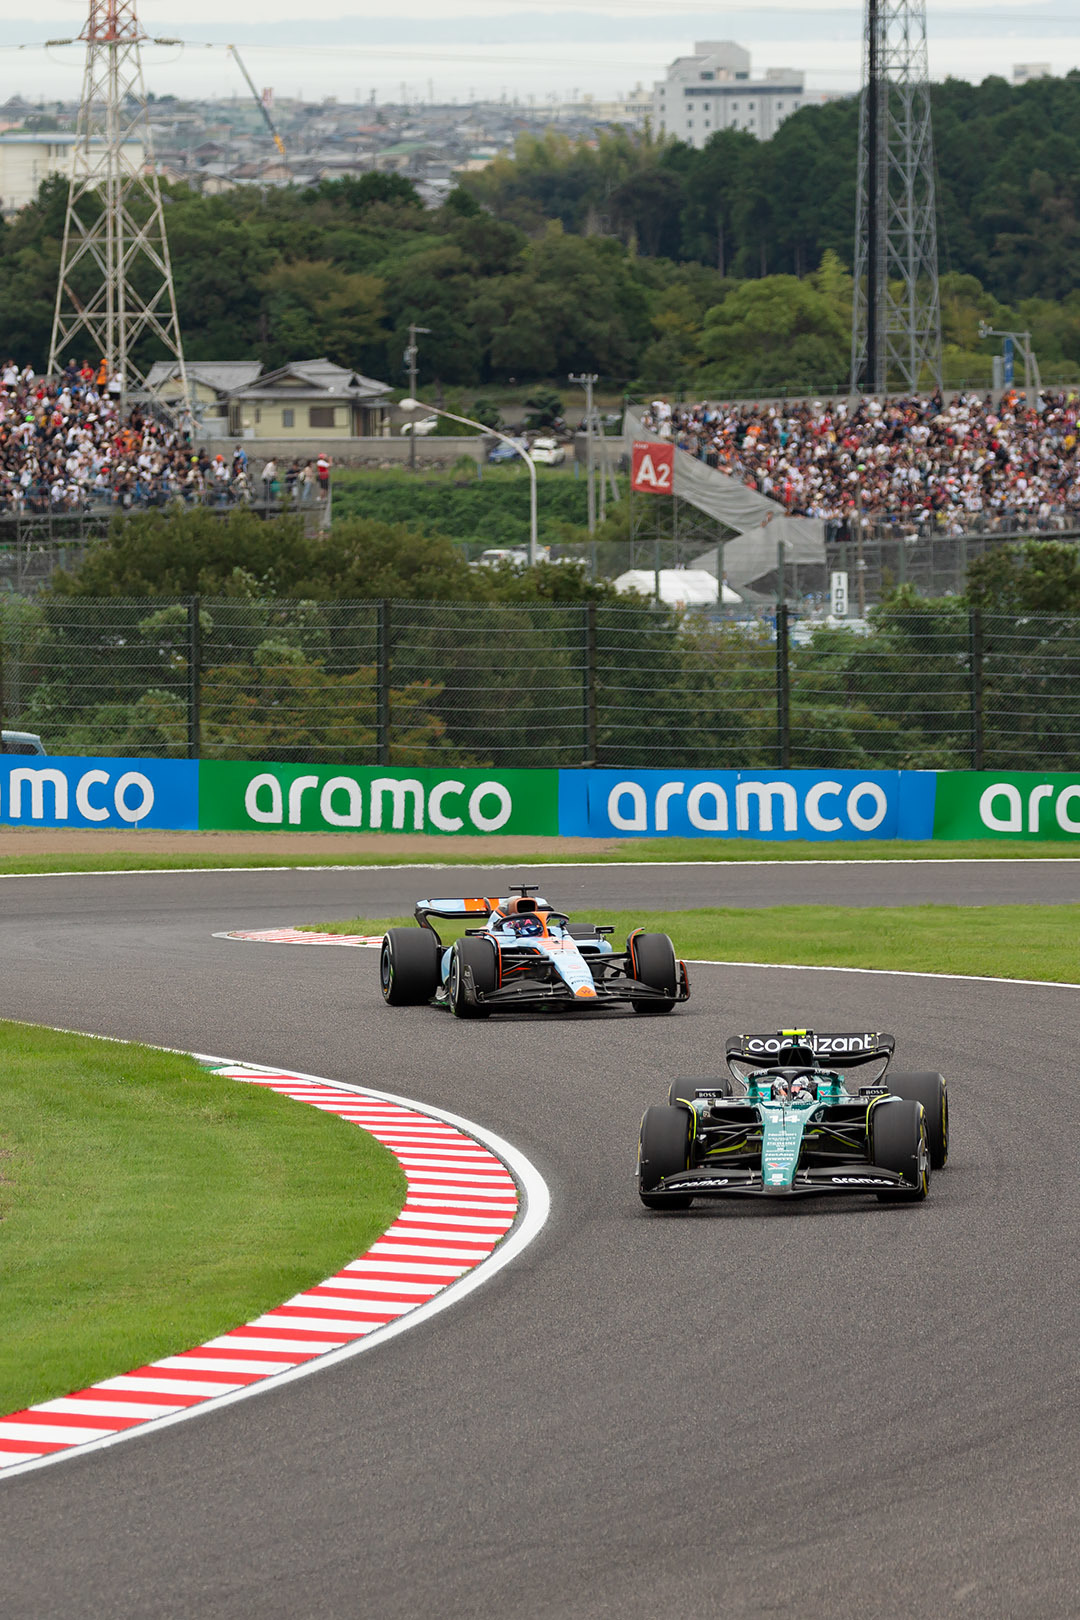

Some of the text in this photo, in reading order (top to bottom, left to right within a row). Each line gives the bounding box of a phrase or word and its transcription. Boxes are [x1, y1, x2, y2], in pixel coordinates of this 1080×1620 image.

[635, 454, 670, 487] A2
[835, 575, 844, 613] 100
[0, 767, 155, 822] mco
[245, 773, 512, 831] aramco
[608, 781, 887, 832] aramco
[769, 1115, 800, 1123] 14
